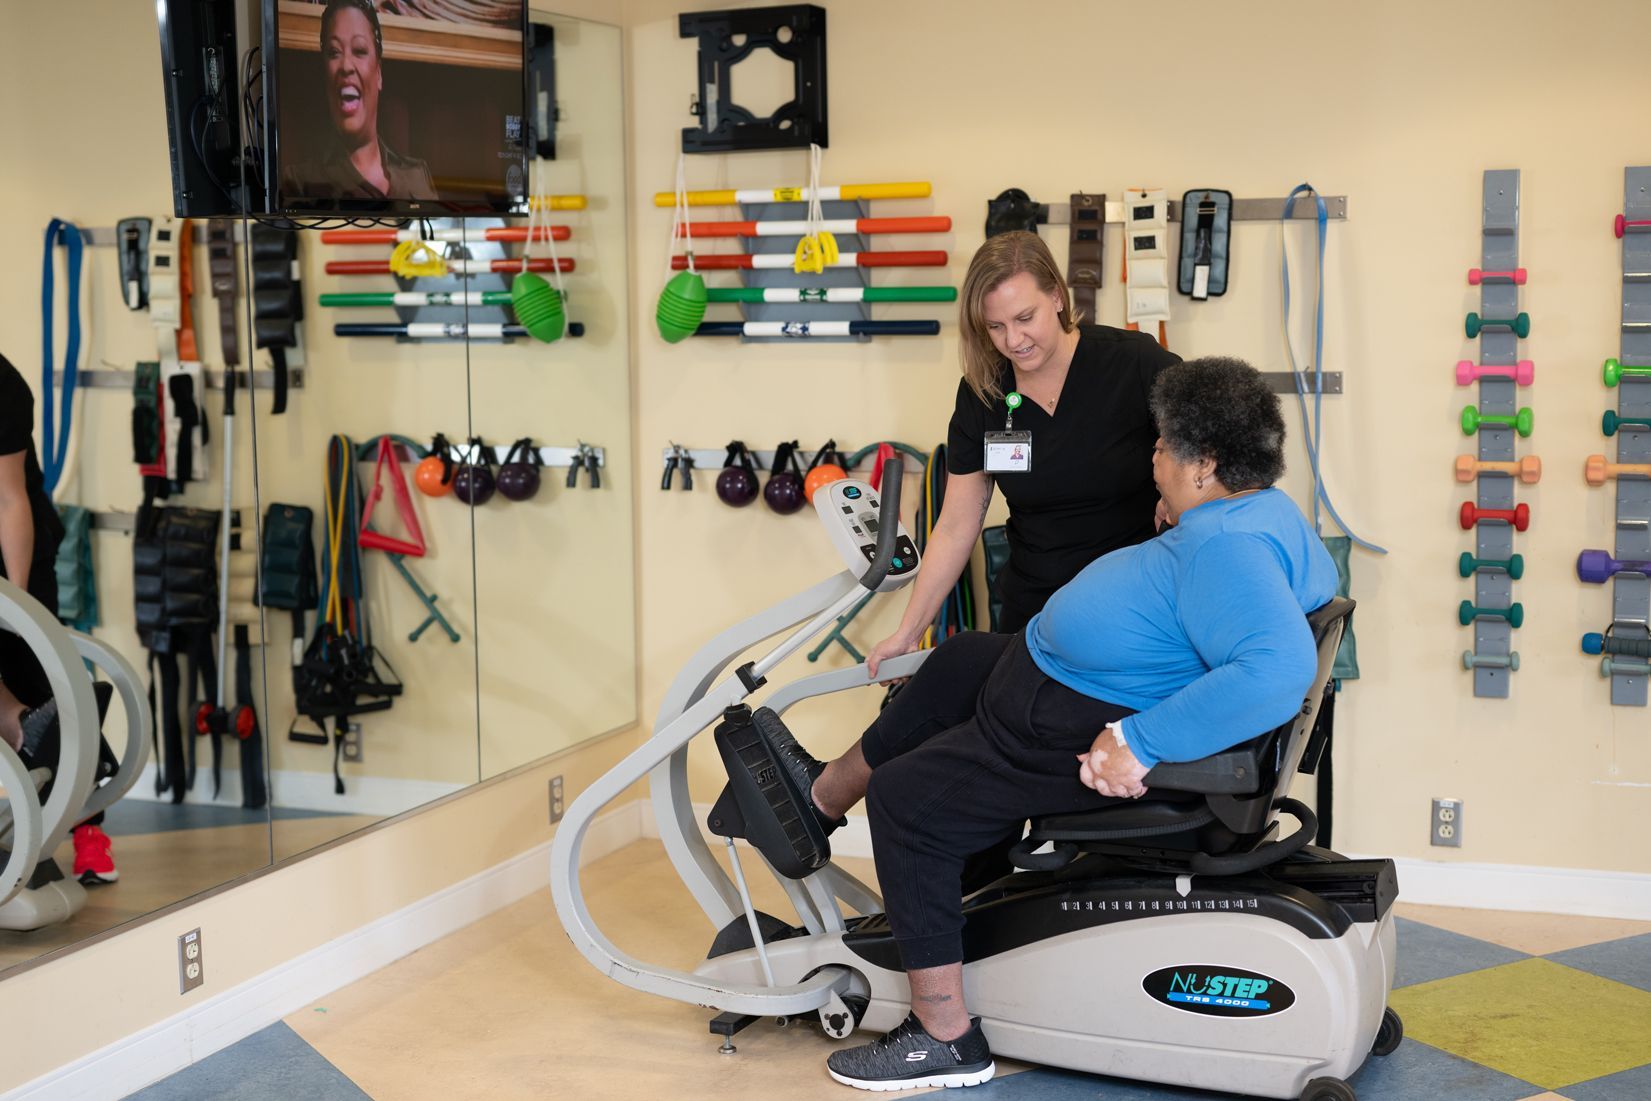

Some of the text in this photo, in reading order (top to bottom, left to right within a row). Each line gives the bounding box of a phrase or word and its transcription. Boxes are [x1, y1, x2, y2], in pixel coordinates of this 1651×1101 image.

[1192, 901, 1198, 909] 11
[1205, 901, 1212, 909] 12
[1219, 901, 1226, 909] 13
[1247, 900, 1255, 908] 15
[1186, 995, 1250, 1007] TRS 4000
